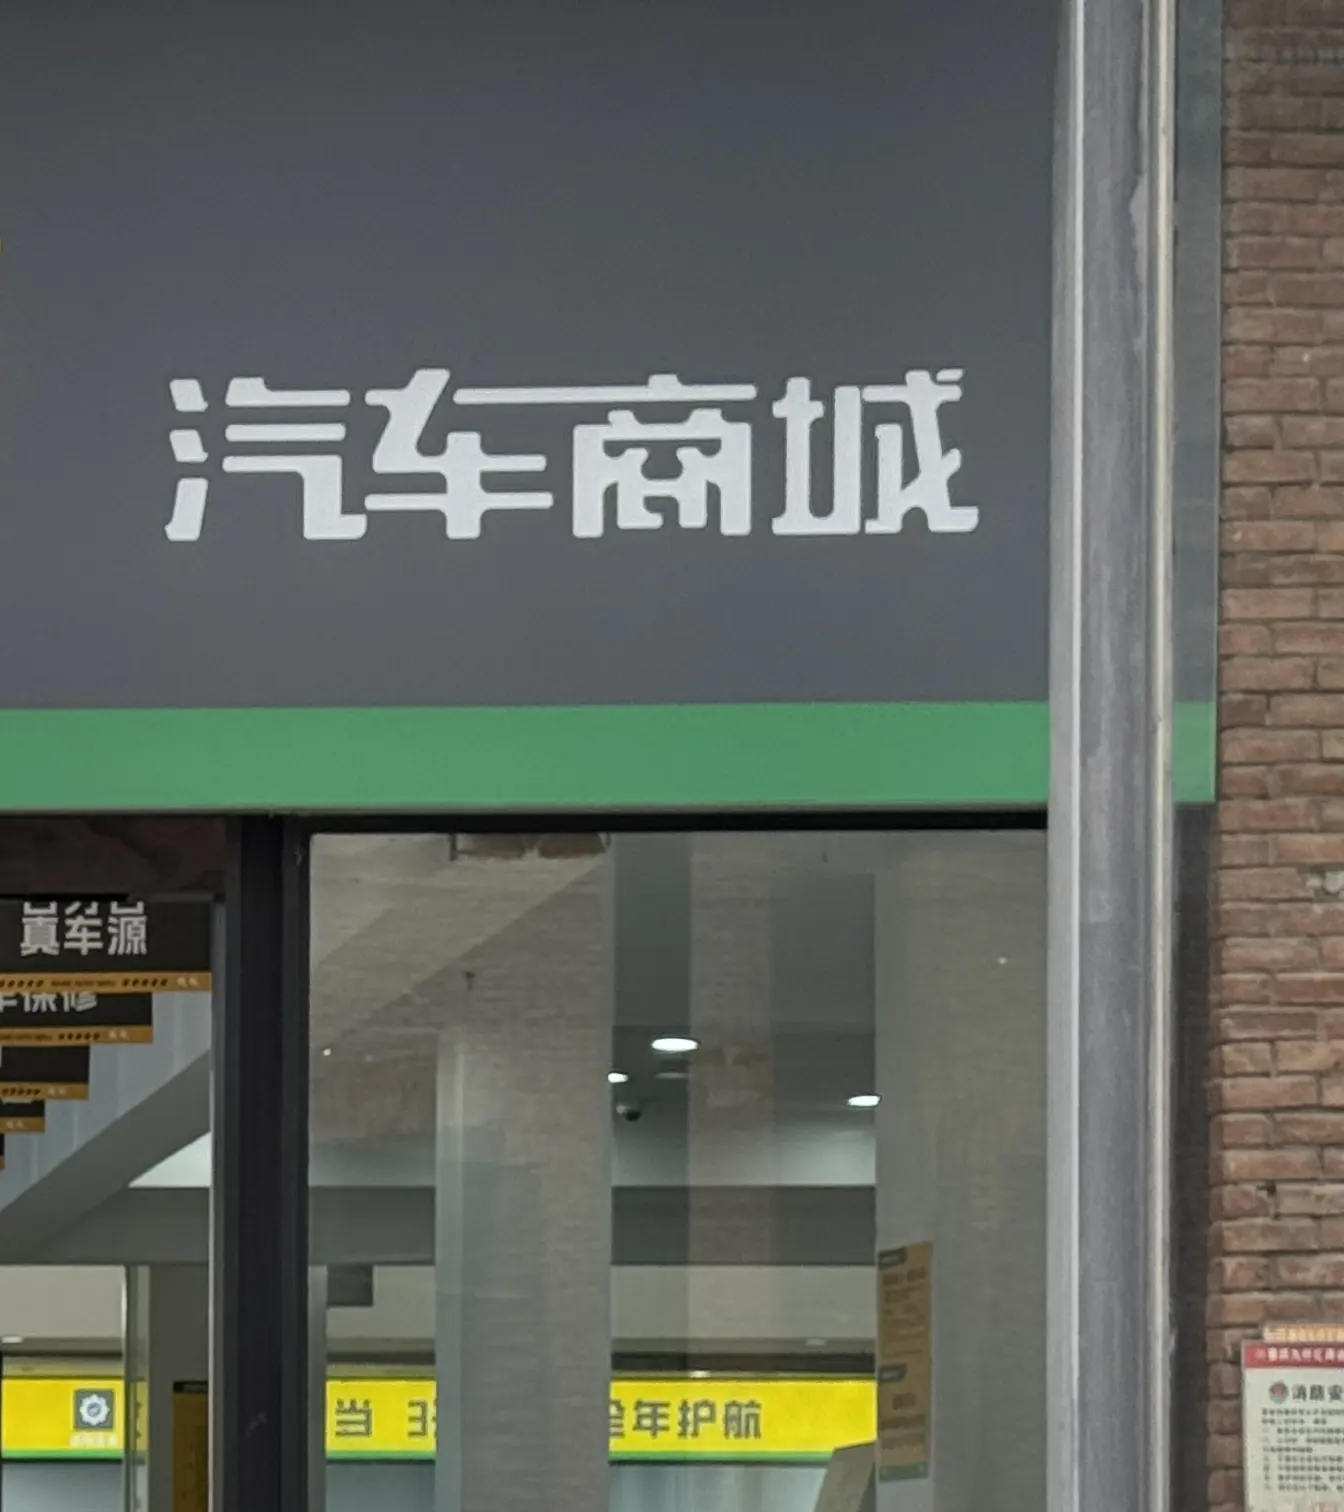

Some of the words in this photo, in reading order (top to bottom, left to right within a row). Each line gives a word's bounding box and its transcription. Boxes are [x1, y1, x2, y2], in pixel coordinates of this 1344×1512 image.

[164, 367, 980, 541] 汽车商城
[19, 913, 149, 957] 真车源
[334, 1398, 372, 1437] 当
